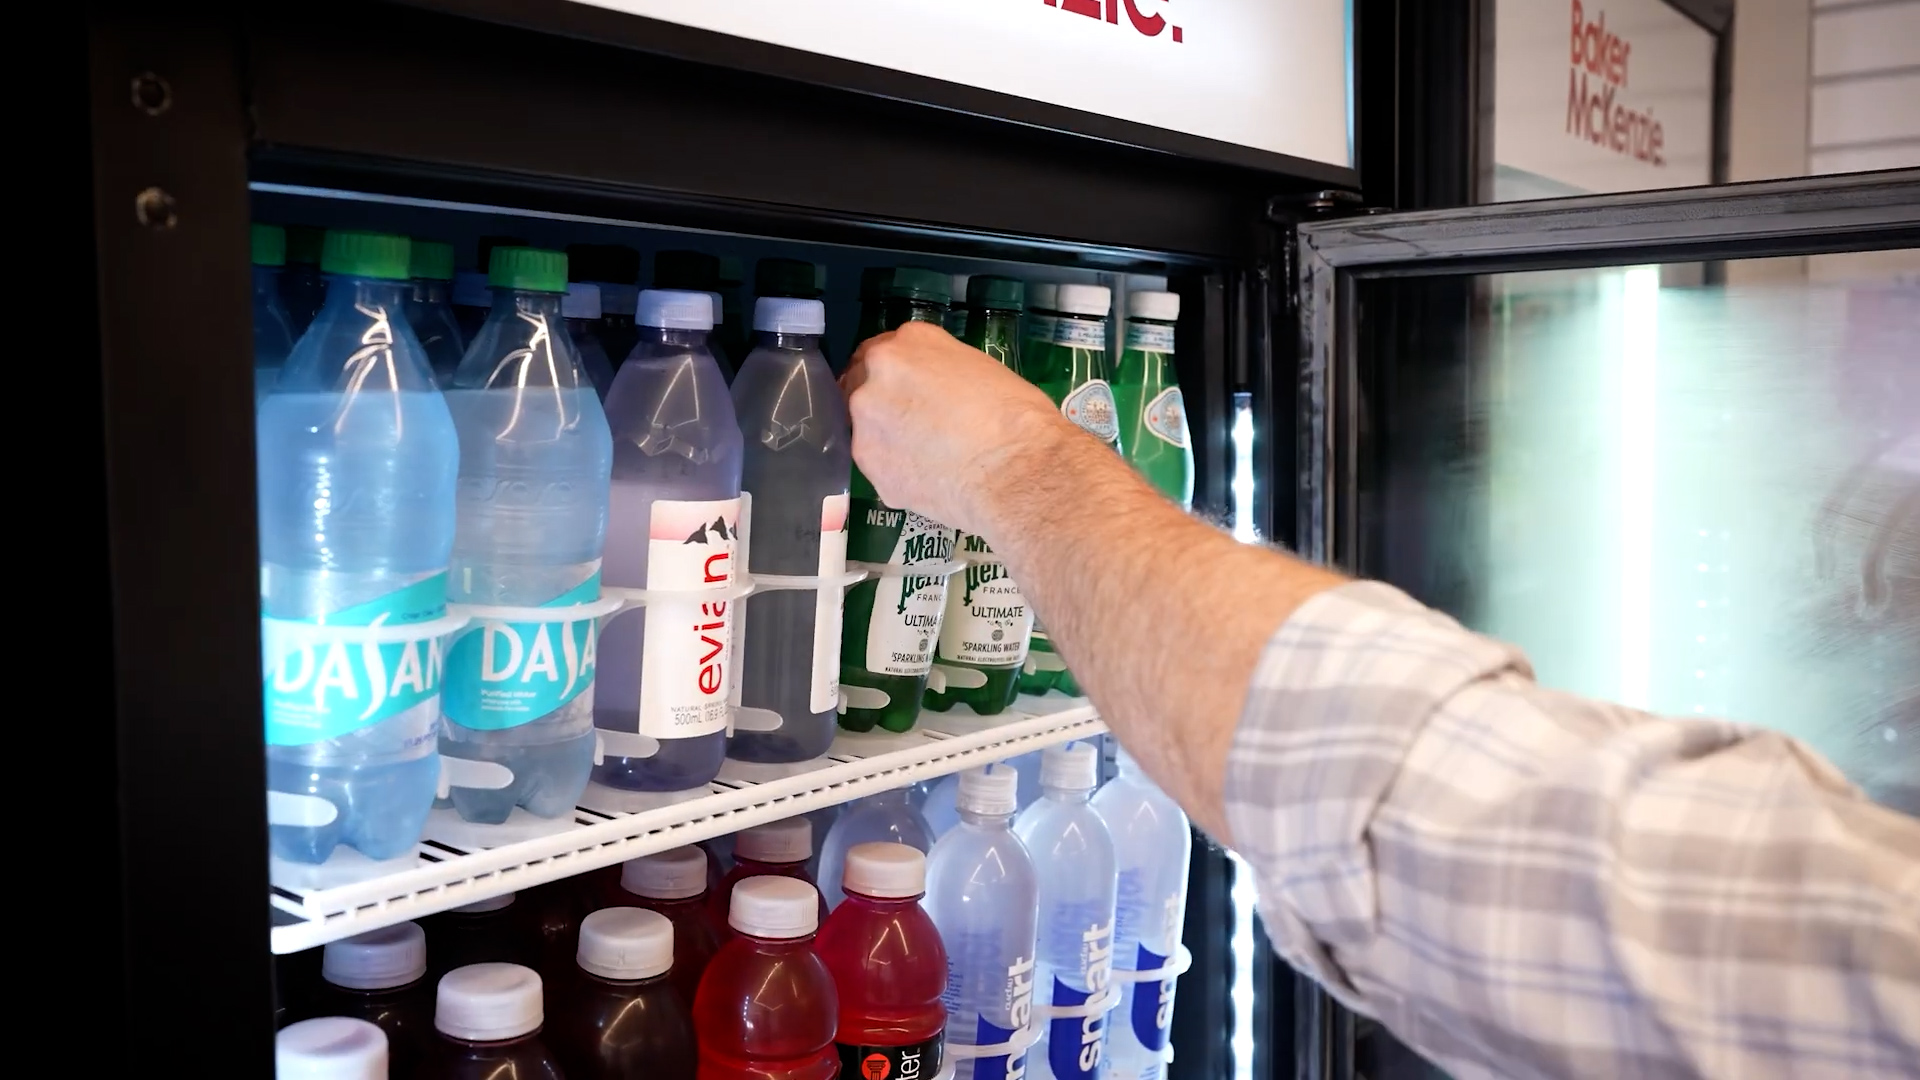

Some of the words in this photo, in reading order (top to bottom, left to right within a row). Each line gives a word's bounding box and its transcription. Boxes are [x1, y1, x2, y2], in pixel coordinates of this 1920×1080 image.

[1570, 0, 1631, 87] Baker
[971, 605, 1025, 619] ULTIMATE
[1003, 641, 1021, 653] WATER
[674, 711, 703, 726] 500mL
